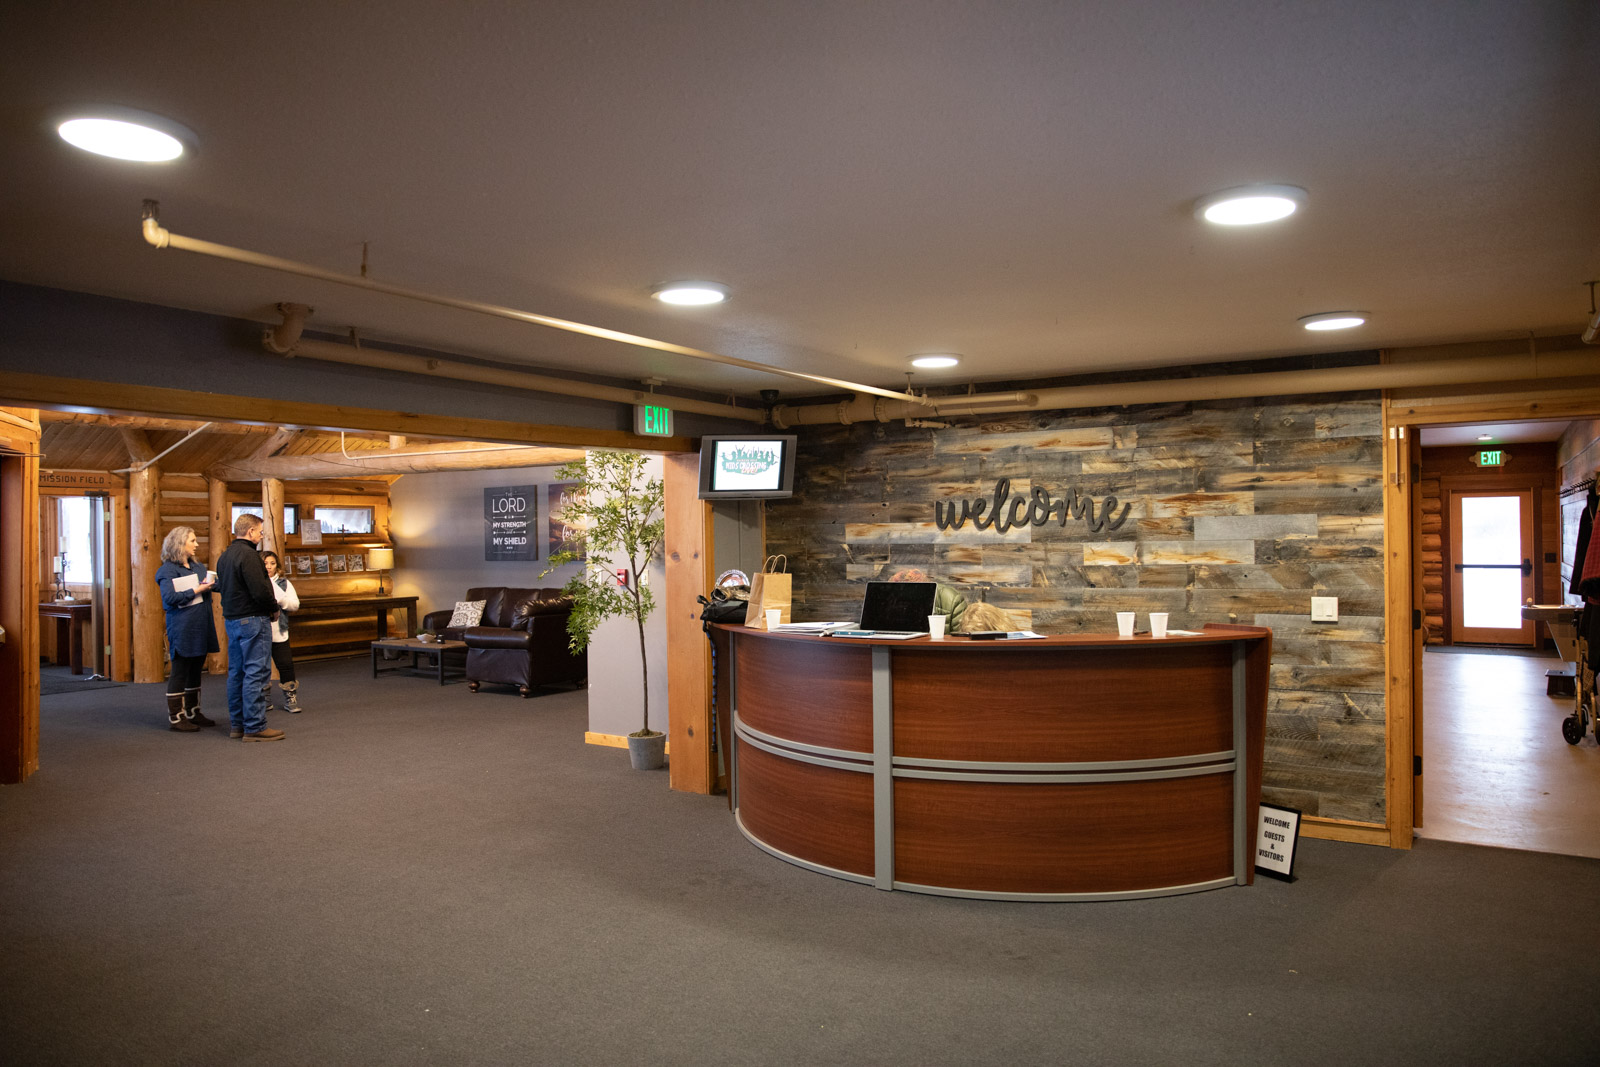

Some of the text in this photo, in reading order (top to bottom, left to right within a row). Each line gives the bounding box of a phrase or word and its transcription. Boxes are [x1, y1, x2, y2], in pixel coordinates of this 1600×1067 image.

[644, 405, 670, 435] EXIT
[1480, 450, 1502, 466] EXIT
[725, 461, 767, 470] KIDS CROSSING
[39, 474, 105, 484] MISSION FIELD
[492, 497, 526, 513] LORD
[935, 477, 1131, 534] welcome
[493, 536, 527, 545] MY SHIELD
[1263, 816, 1290, 829] WELCOME
[1263, 830, 1285, 843] GUESTS
[1258, 849, 1285, 863] VISITORS
